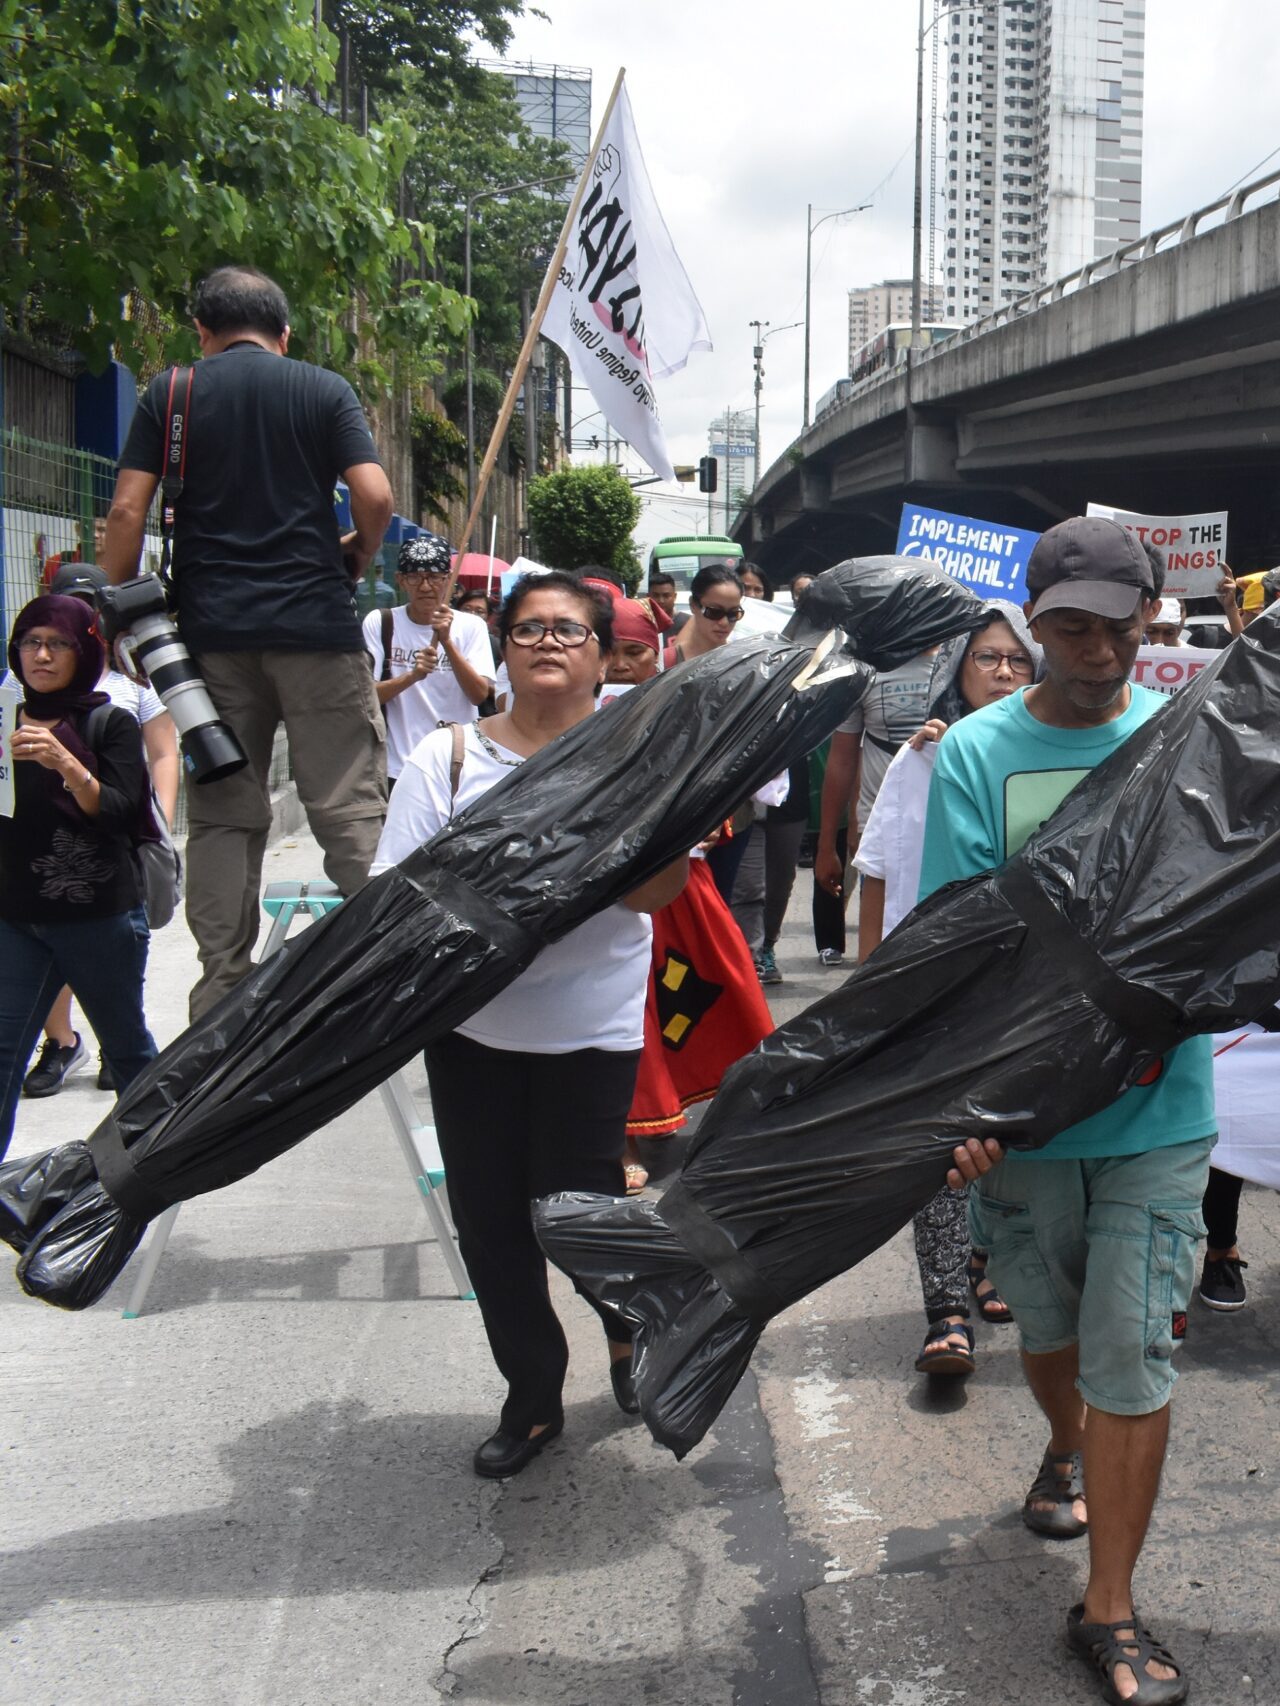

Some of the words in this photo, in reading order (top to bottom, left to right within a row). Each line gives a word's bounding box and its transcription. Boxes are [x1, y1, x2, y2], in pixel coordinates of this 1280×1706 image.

[172, 414, 183, 441] EOS
[170, 444, 181, 464] 50D
[908, 514, 1020, 557] IMPLEMENT
[1124, 525, 1182, 546] TOP
[1189, 523, 1222, 544] THE
